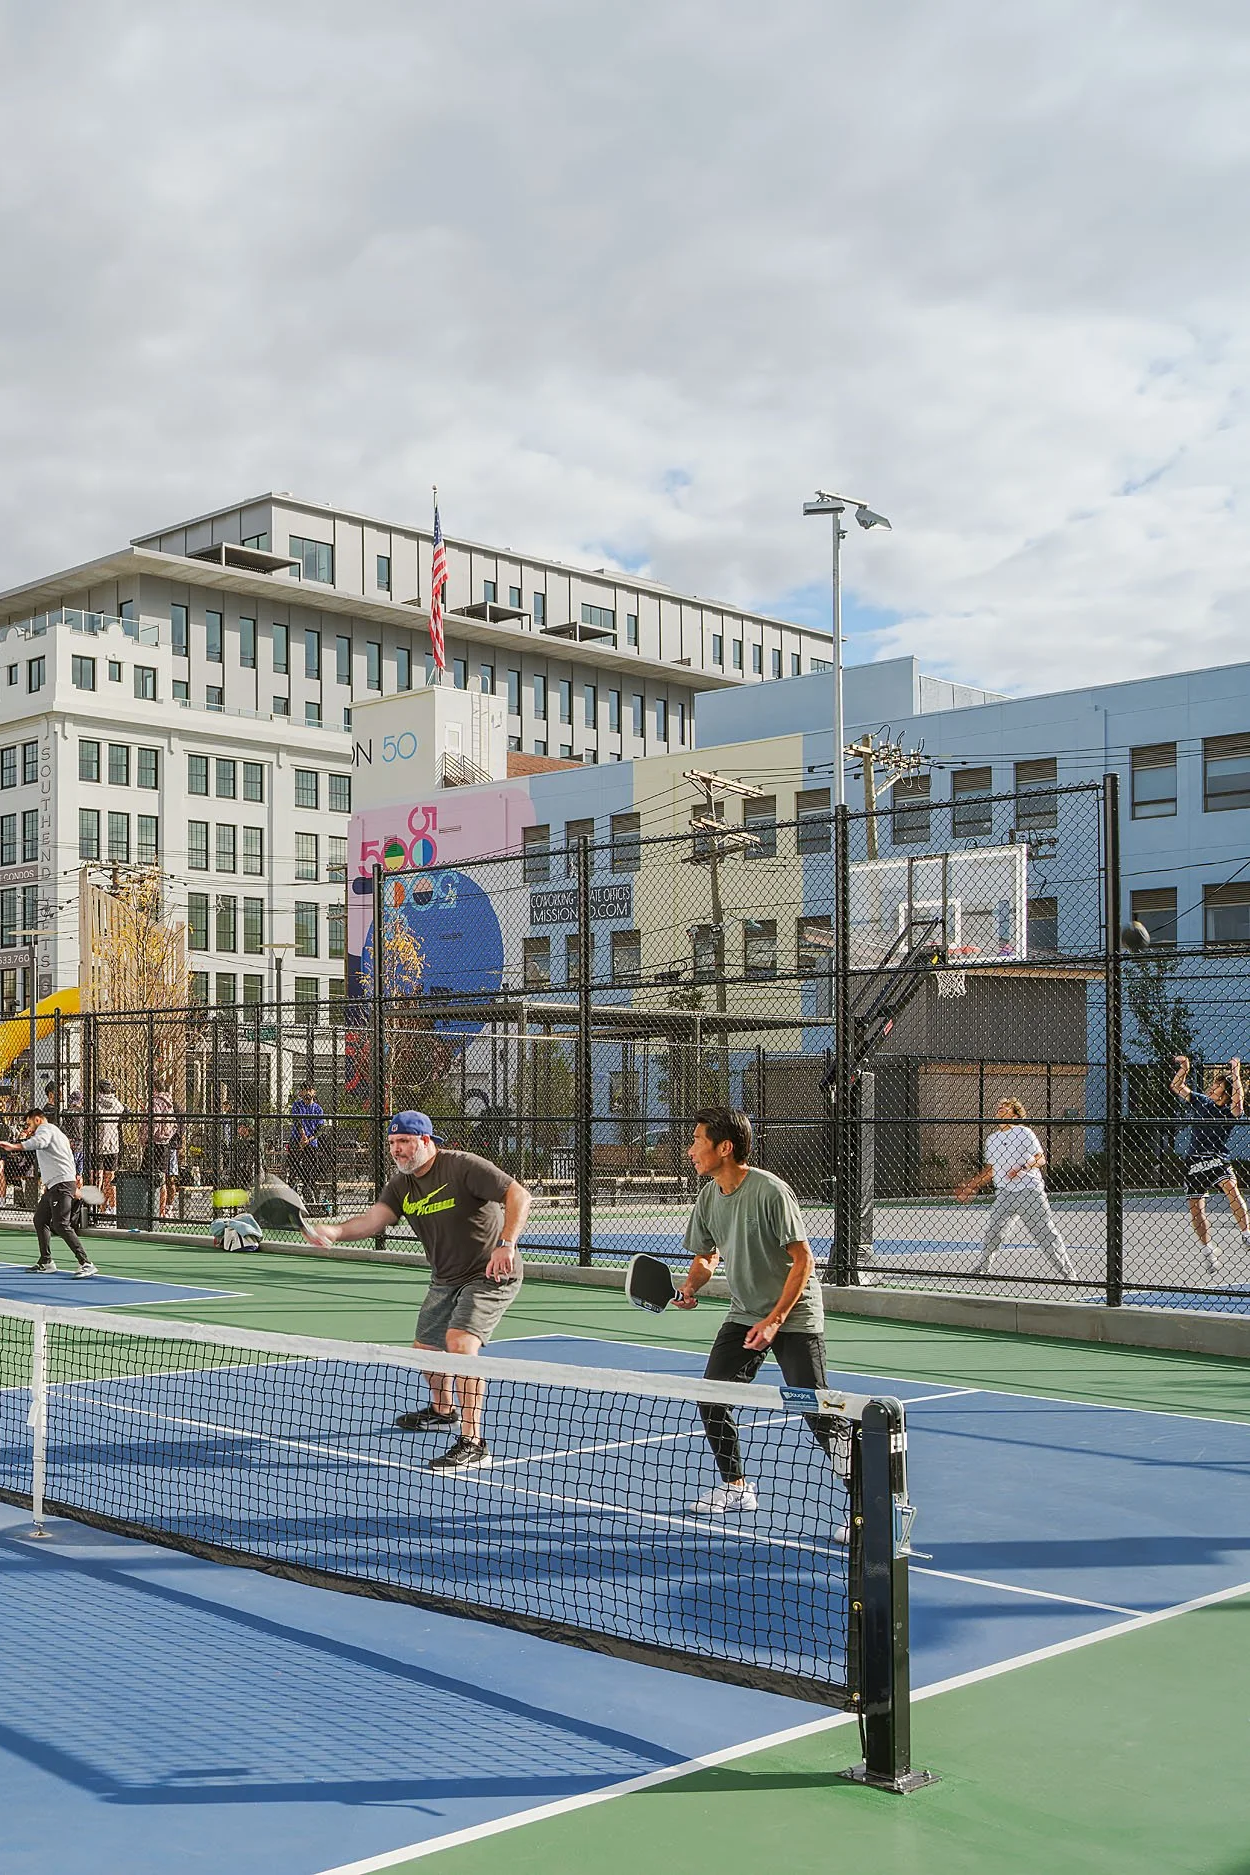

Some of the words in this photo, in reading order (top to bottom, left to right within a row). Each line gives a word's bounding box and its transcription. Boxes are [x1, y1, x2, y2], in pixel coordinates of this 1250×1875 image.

[382, 732, 418, 763] 50
[3, 868, 35, 882] CONDOS
[533, 902, 628, 923] MISSION0.COM
